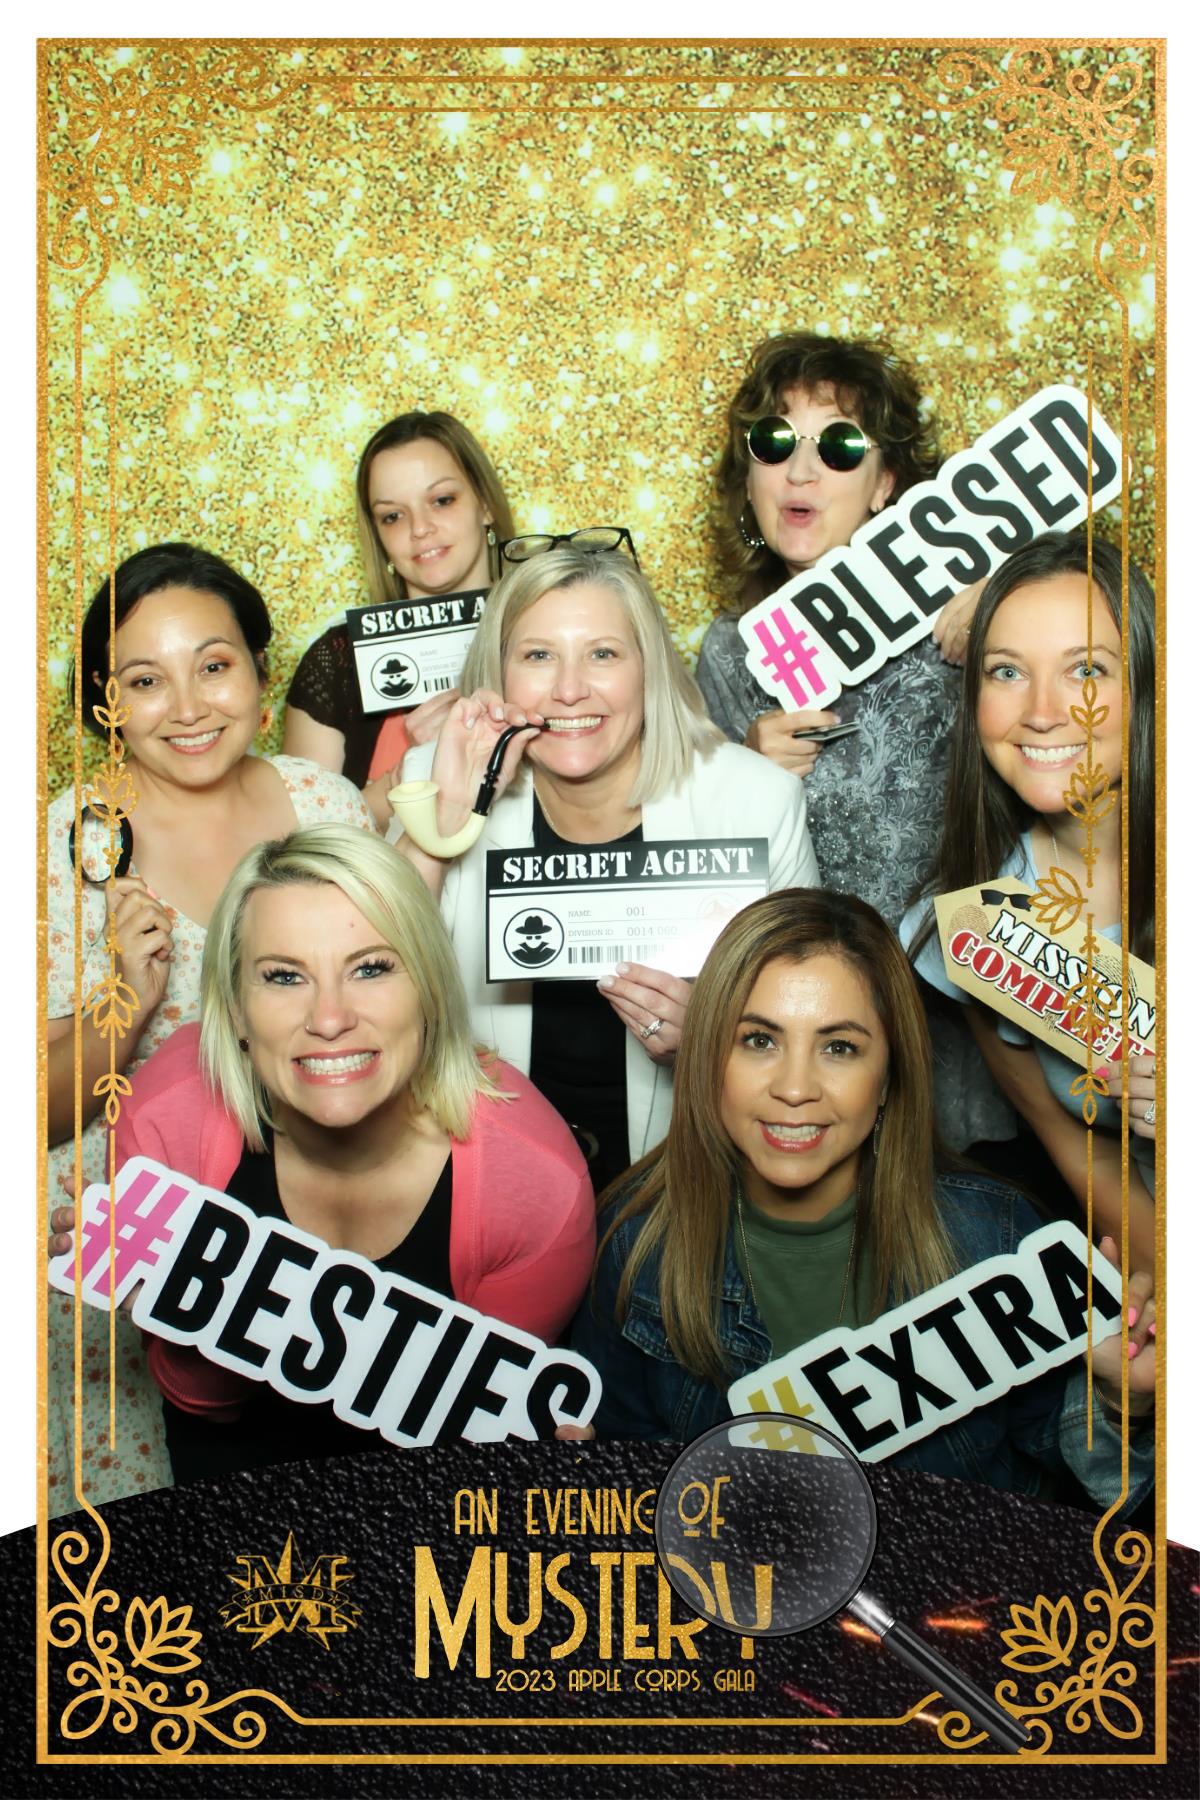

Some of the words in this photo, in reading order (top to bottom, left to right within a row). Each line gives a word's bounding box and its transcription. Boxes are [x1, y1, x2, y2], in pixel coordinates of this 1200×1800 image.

[361, 599, 465, 635] SECRET
[753, 399, 1117, 708] #BLESSED
[503, 851, 631, 883] SECRET
[641, 847, 753, 876] AGENT
[626, 906, 646, 917] 001
[949, 929, 1156, 1063] COMPLET
[987, 909, 1156, 1039] MISSION
[64, 1170, 591, 1445] #BESTIES
[747, 1240, 1121, 1455] #EXTRA
